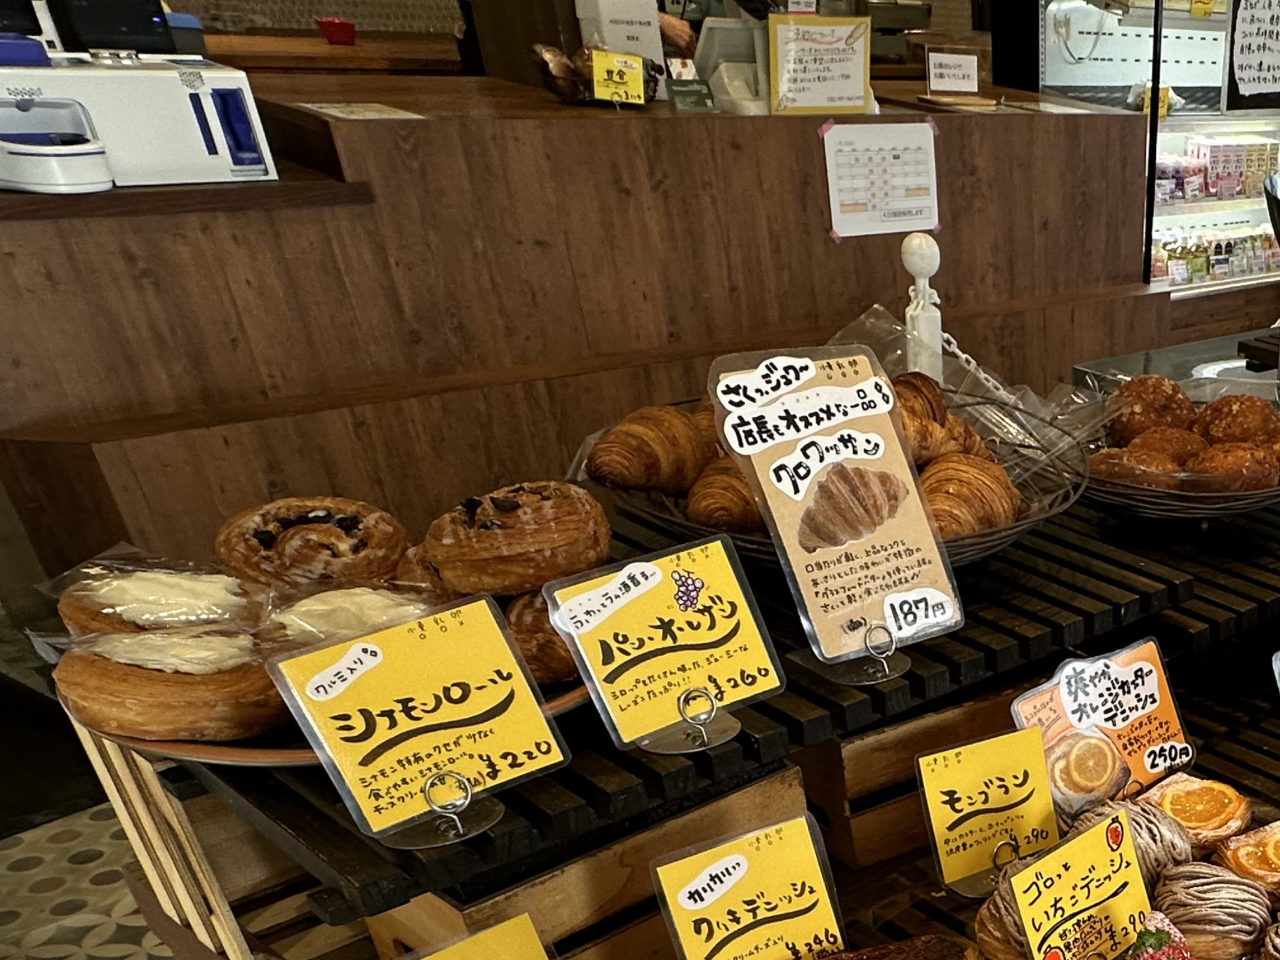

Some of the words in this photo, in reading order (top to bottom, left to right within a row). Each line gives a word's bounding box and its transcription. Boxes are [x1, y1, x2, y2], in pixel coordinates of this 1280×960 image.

[772, 433, 880, 495] クロワッサン
[889, 597, 947, 631] 187円
[707, 666, 770, 702] ¥260
[328, 668, 514, 744] シナモンロール
[478, 739, 552, 781] ¥220
[1147, 745, 1193, 770] 250円
[1031, 853, 1132, 932] いちごデニッシュ
